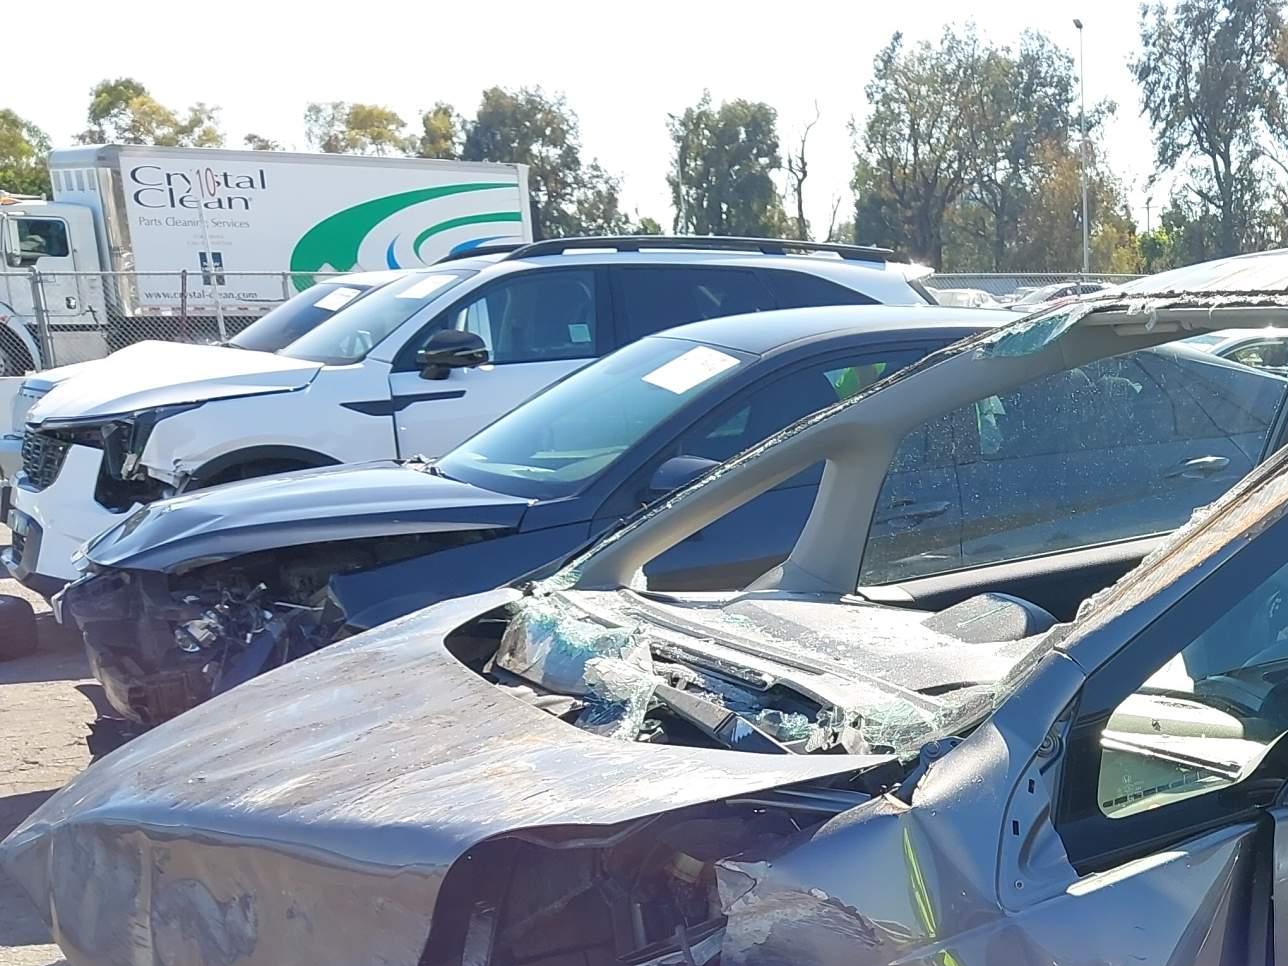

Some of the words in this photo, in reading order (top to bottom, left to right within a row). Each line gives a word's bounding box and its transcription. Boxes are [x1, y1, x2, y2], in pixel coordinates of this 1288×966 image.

[139, 216, 162, 226] Parts
[165, 217, 209, 229] Cleanin
[210, 218, 250, 228] Services
